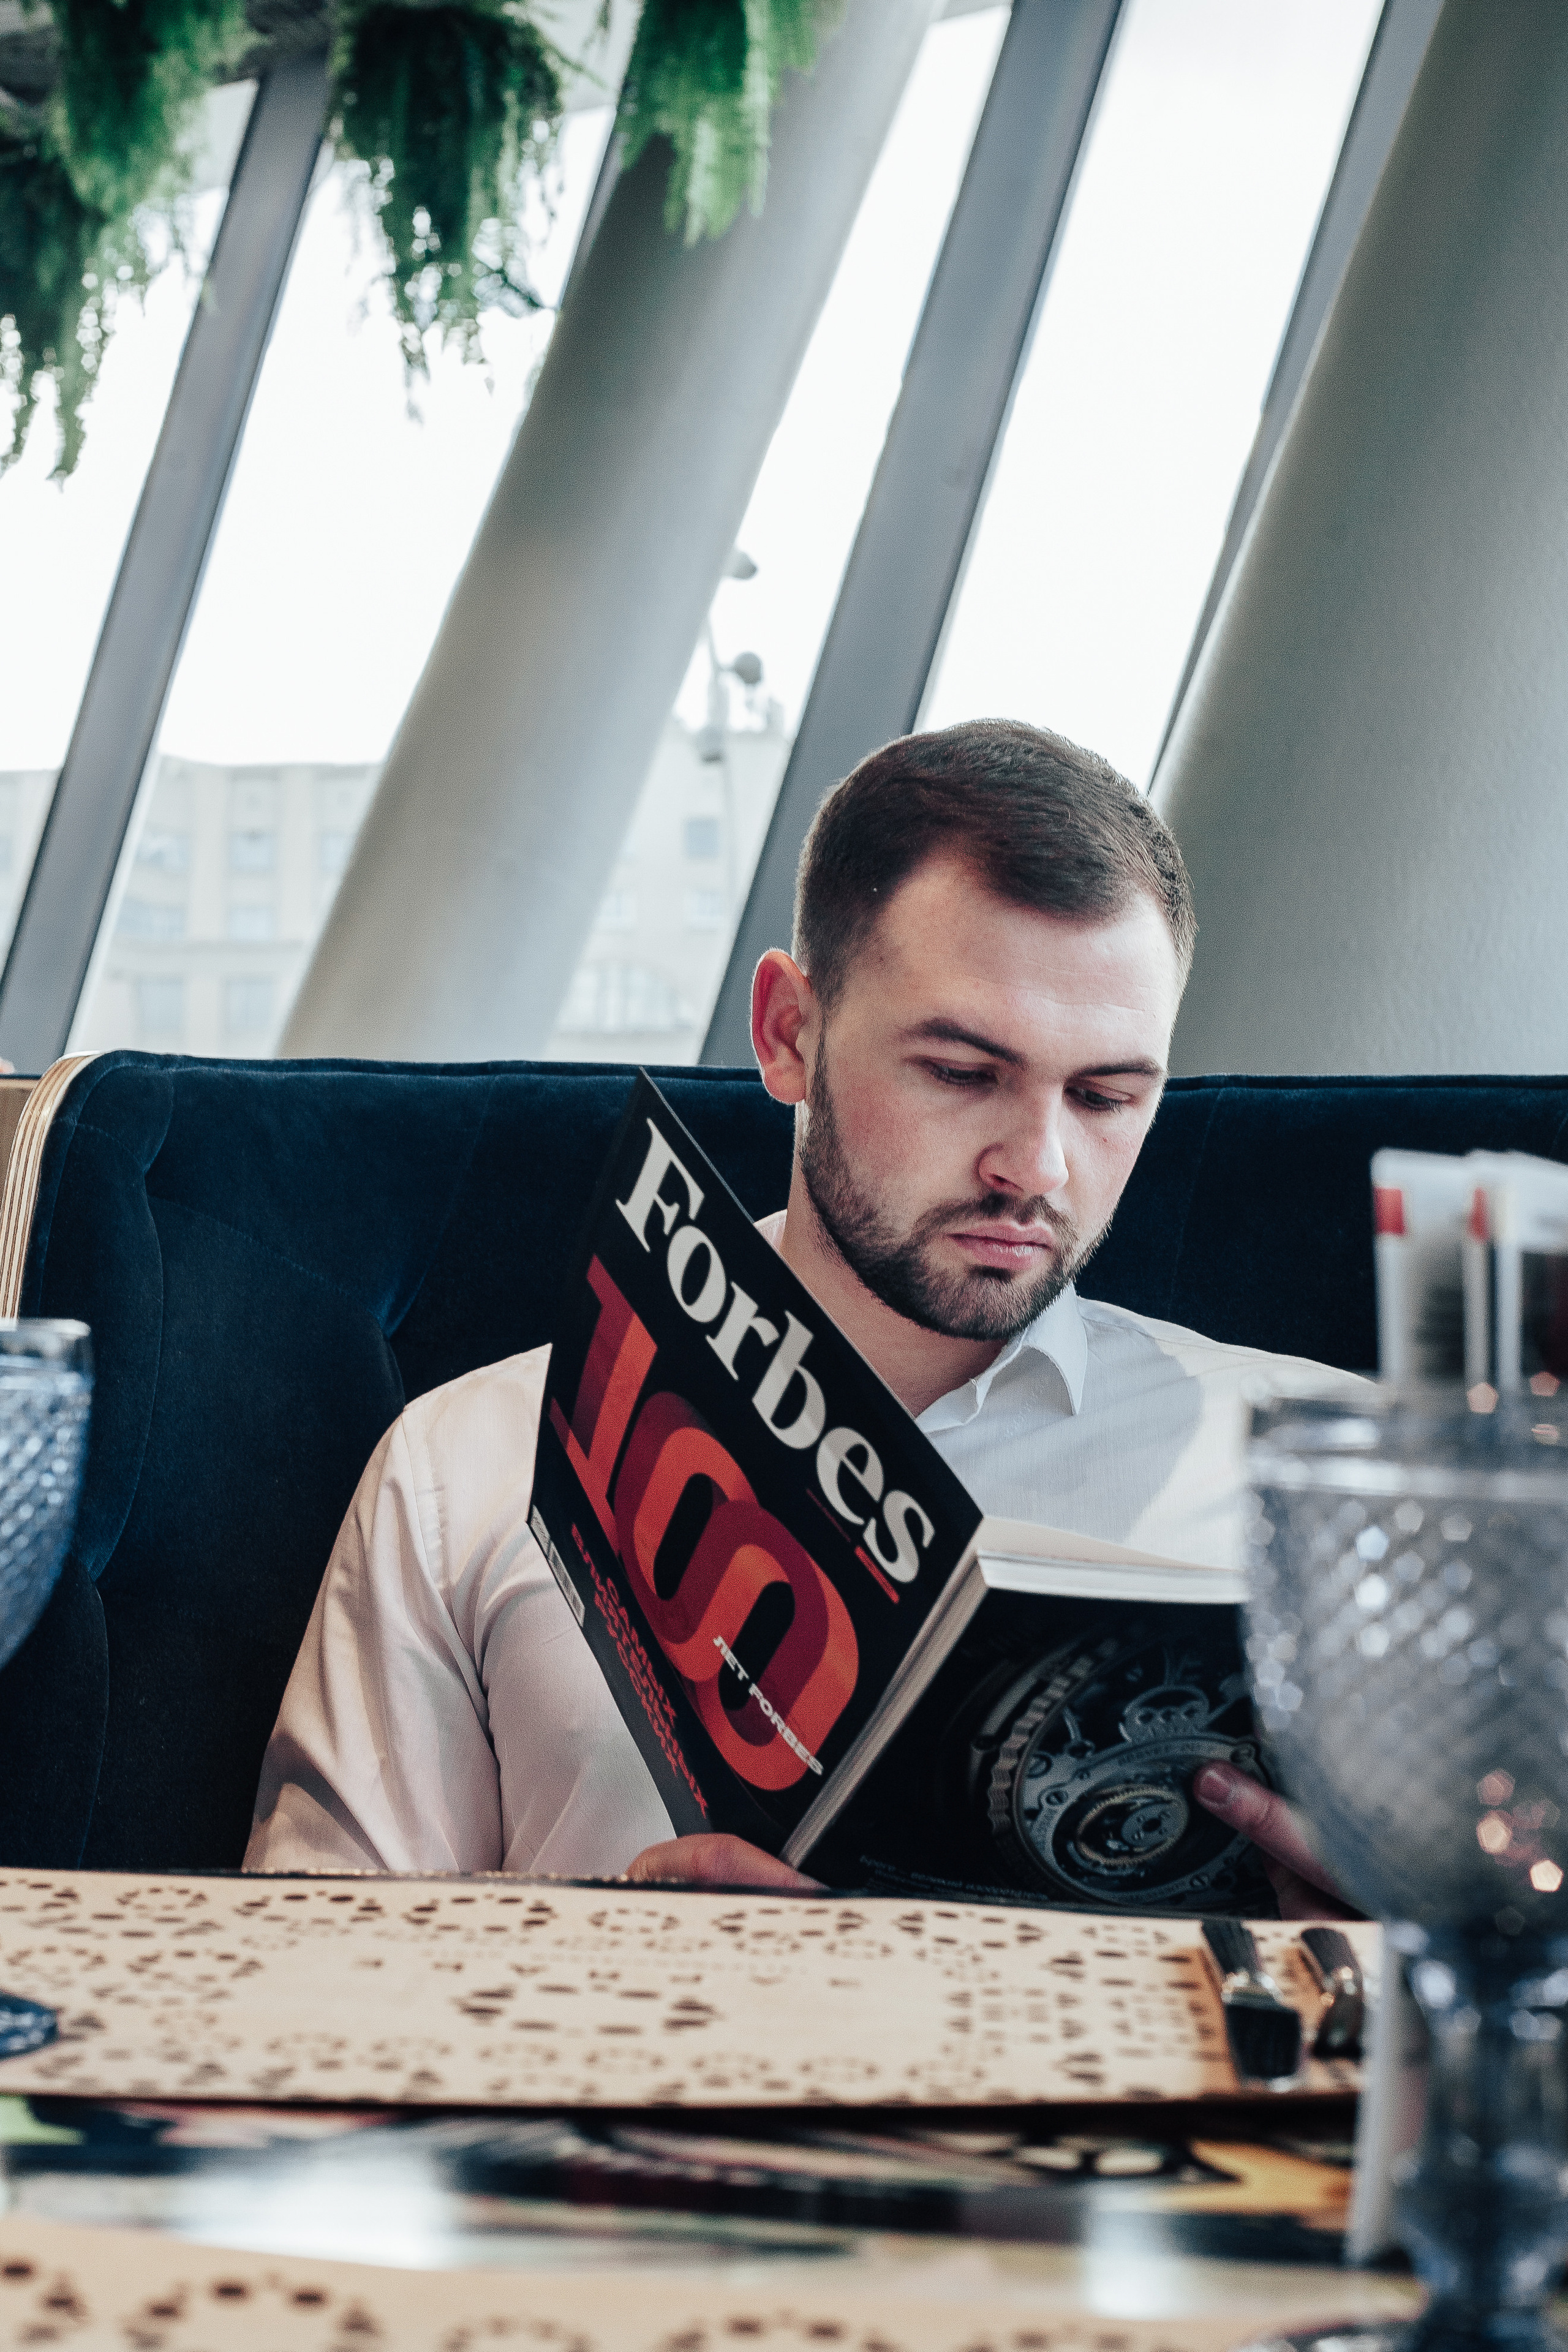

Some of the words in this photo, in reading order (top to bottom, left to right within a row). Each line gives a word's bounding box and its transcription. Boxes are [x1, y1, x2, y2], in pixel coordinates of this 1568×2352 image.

[615, 1118, 935, 1583] Forbes
[549, 1253, 859, 1790] 100
[571, 1522, 709, 1819] ВЛИЯТЕЛЬНЫХ
[594, 1592, 677, 1777] РУССКИХ
[607, 1577, 677, 1717] САМЫХ
[712, 1635, 750, 1681] ЛЕТ
[748, 1682, 824, 1776] FORBES
